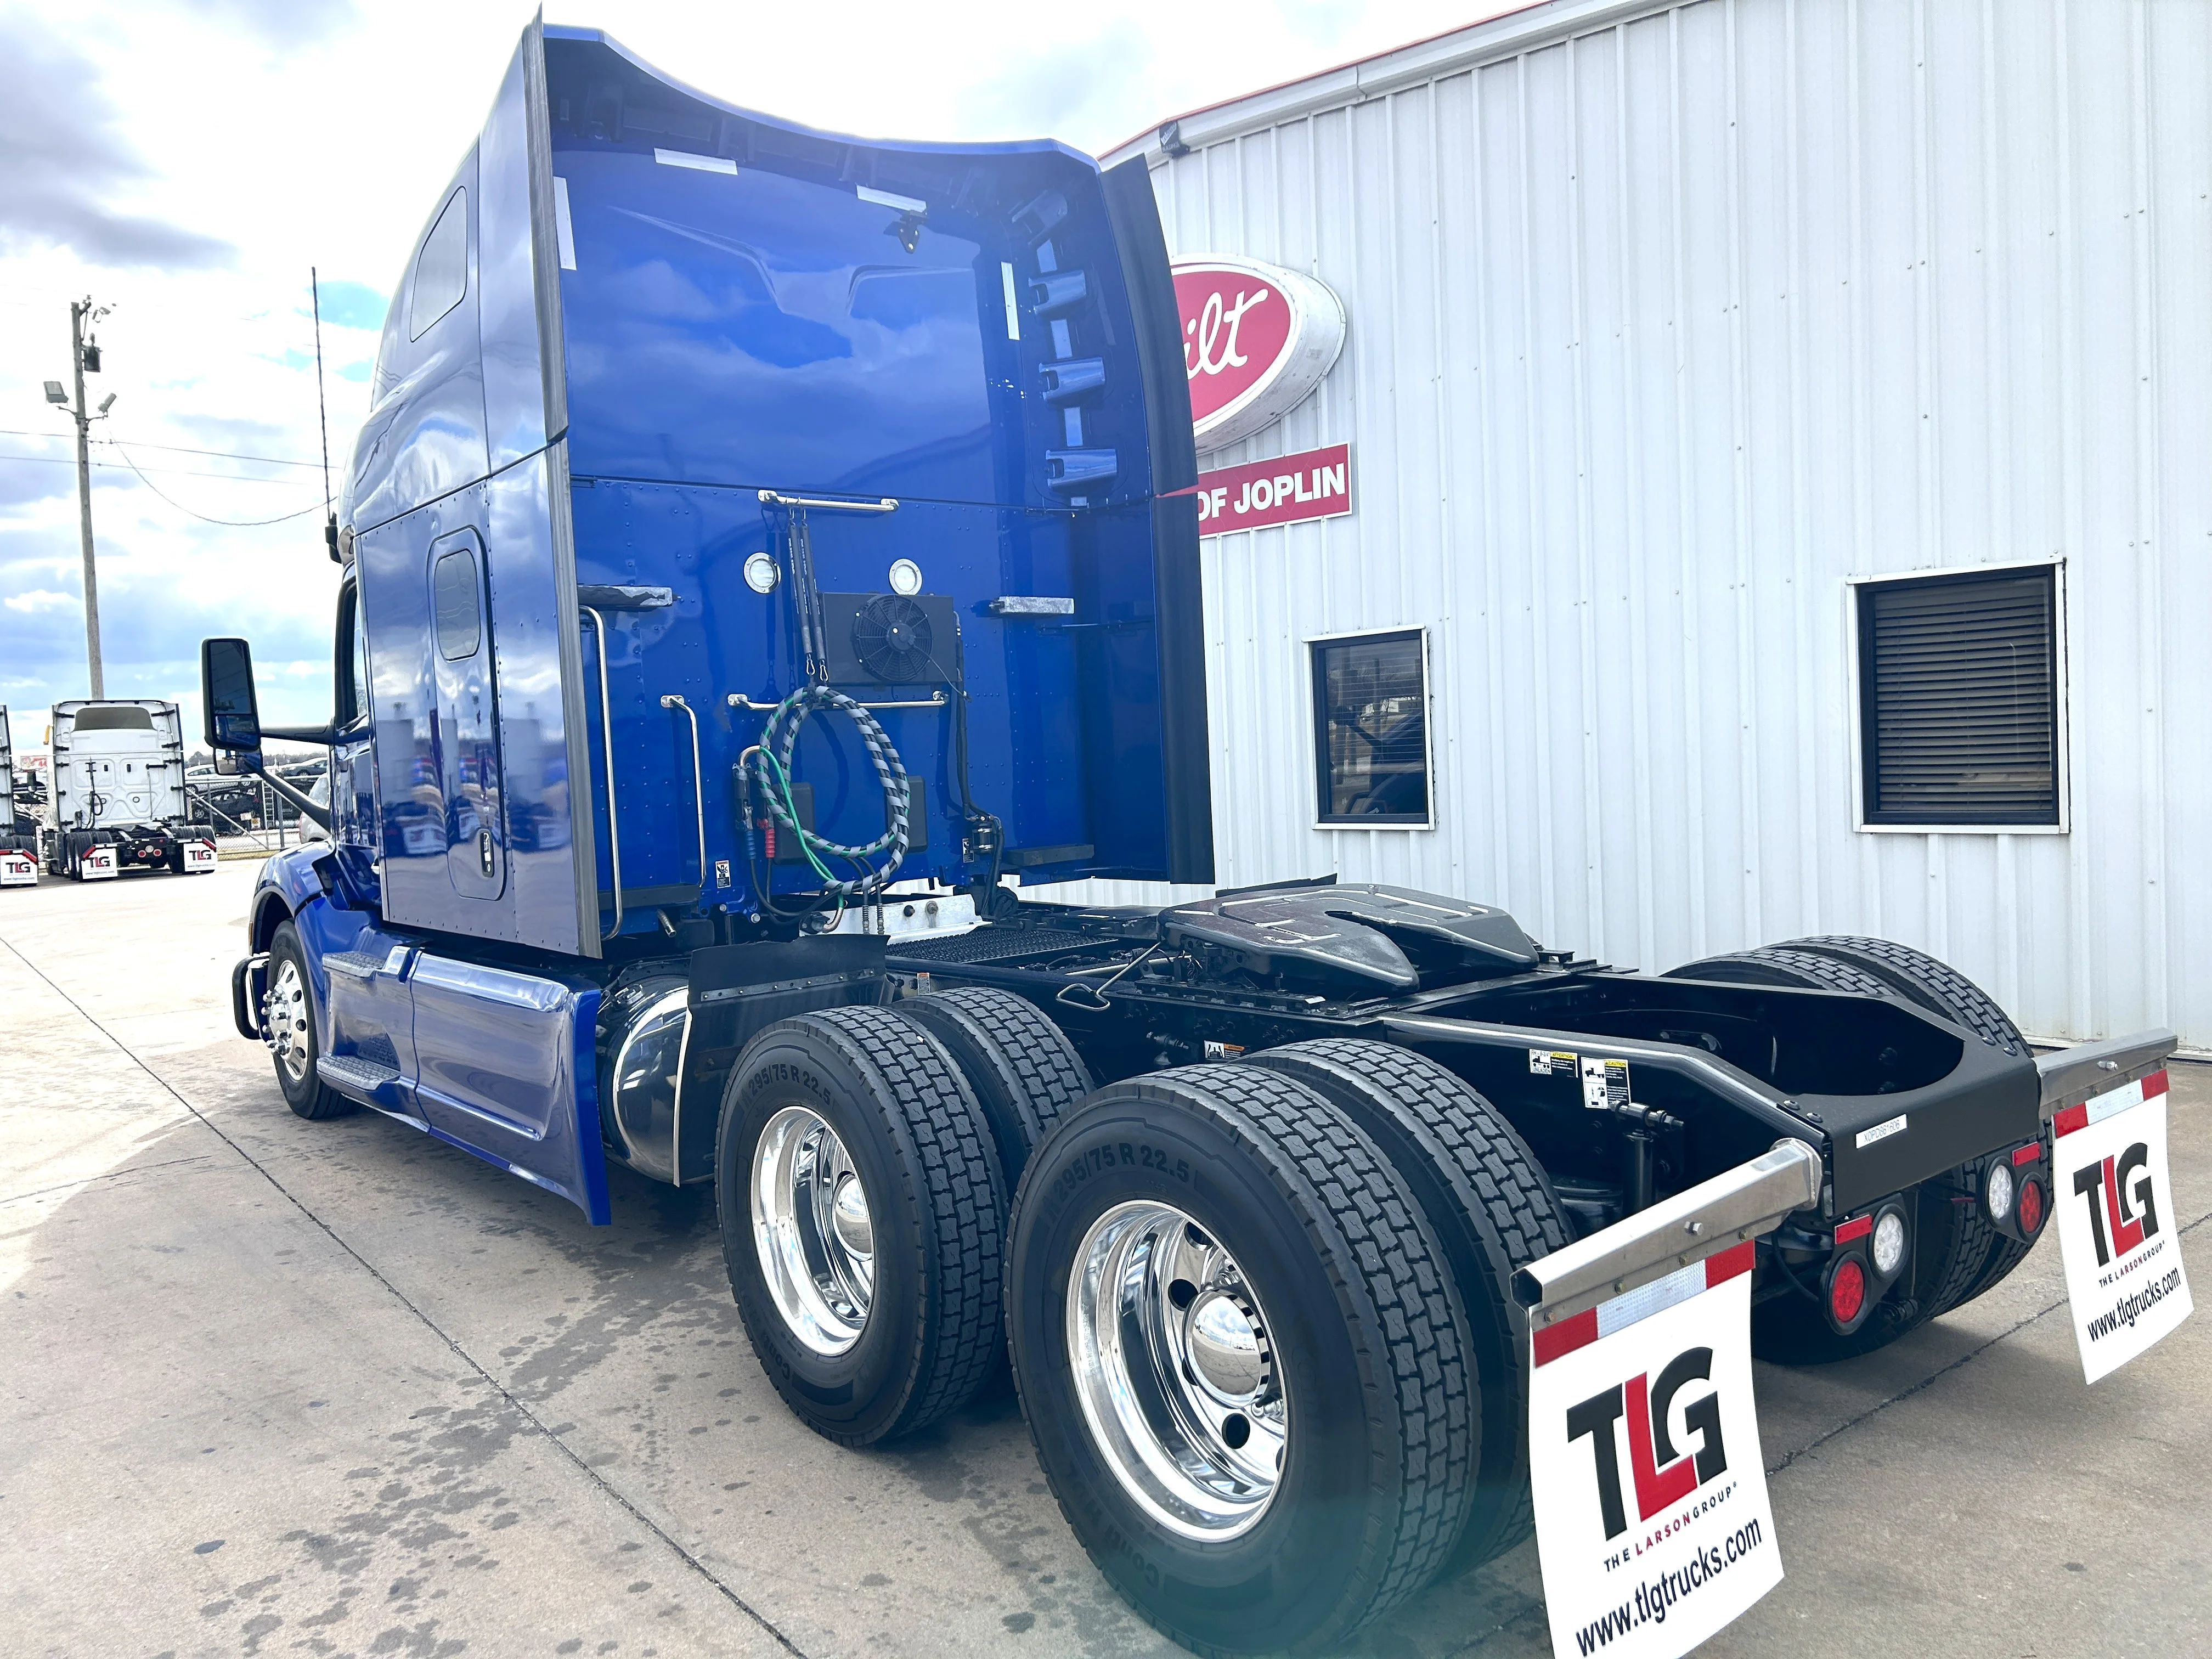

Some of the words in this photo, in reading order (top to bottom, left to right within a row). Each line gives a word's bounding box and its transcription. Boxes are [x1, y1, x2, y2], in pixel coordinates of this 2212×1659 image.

[1234, 462, 1345, 514] JOPLIN
[5, 862, 30, 873] TLG
[88, 856, 110, 868] TLG
[189, 850, 212, 861] TLG
[748, 1063, 788, 1096] 295/75
[791, 1064, 800, 1083] R
[803, 1071, 831, 1105] 22.5
[1054, 1144, 1116, 1203] 295/75
[1119, 1142, 1136, 1165] R
[1140, 1145, 1189, 1183] 22.5
[2073, 1142, 2159, 1267] TLG
[2087, 1267, 2181, 1342] www.tlgtrucks.com
[2099, 1274, 2113, 1288] THE
[1567, 1346, 1727, 1541] TLG
[1604, 1548, 1630, 1572] THE
[1576, 1518, 1762, 1658] www.tlgtrucks.com
